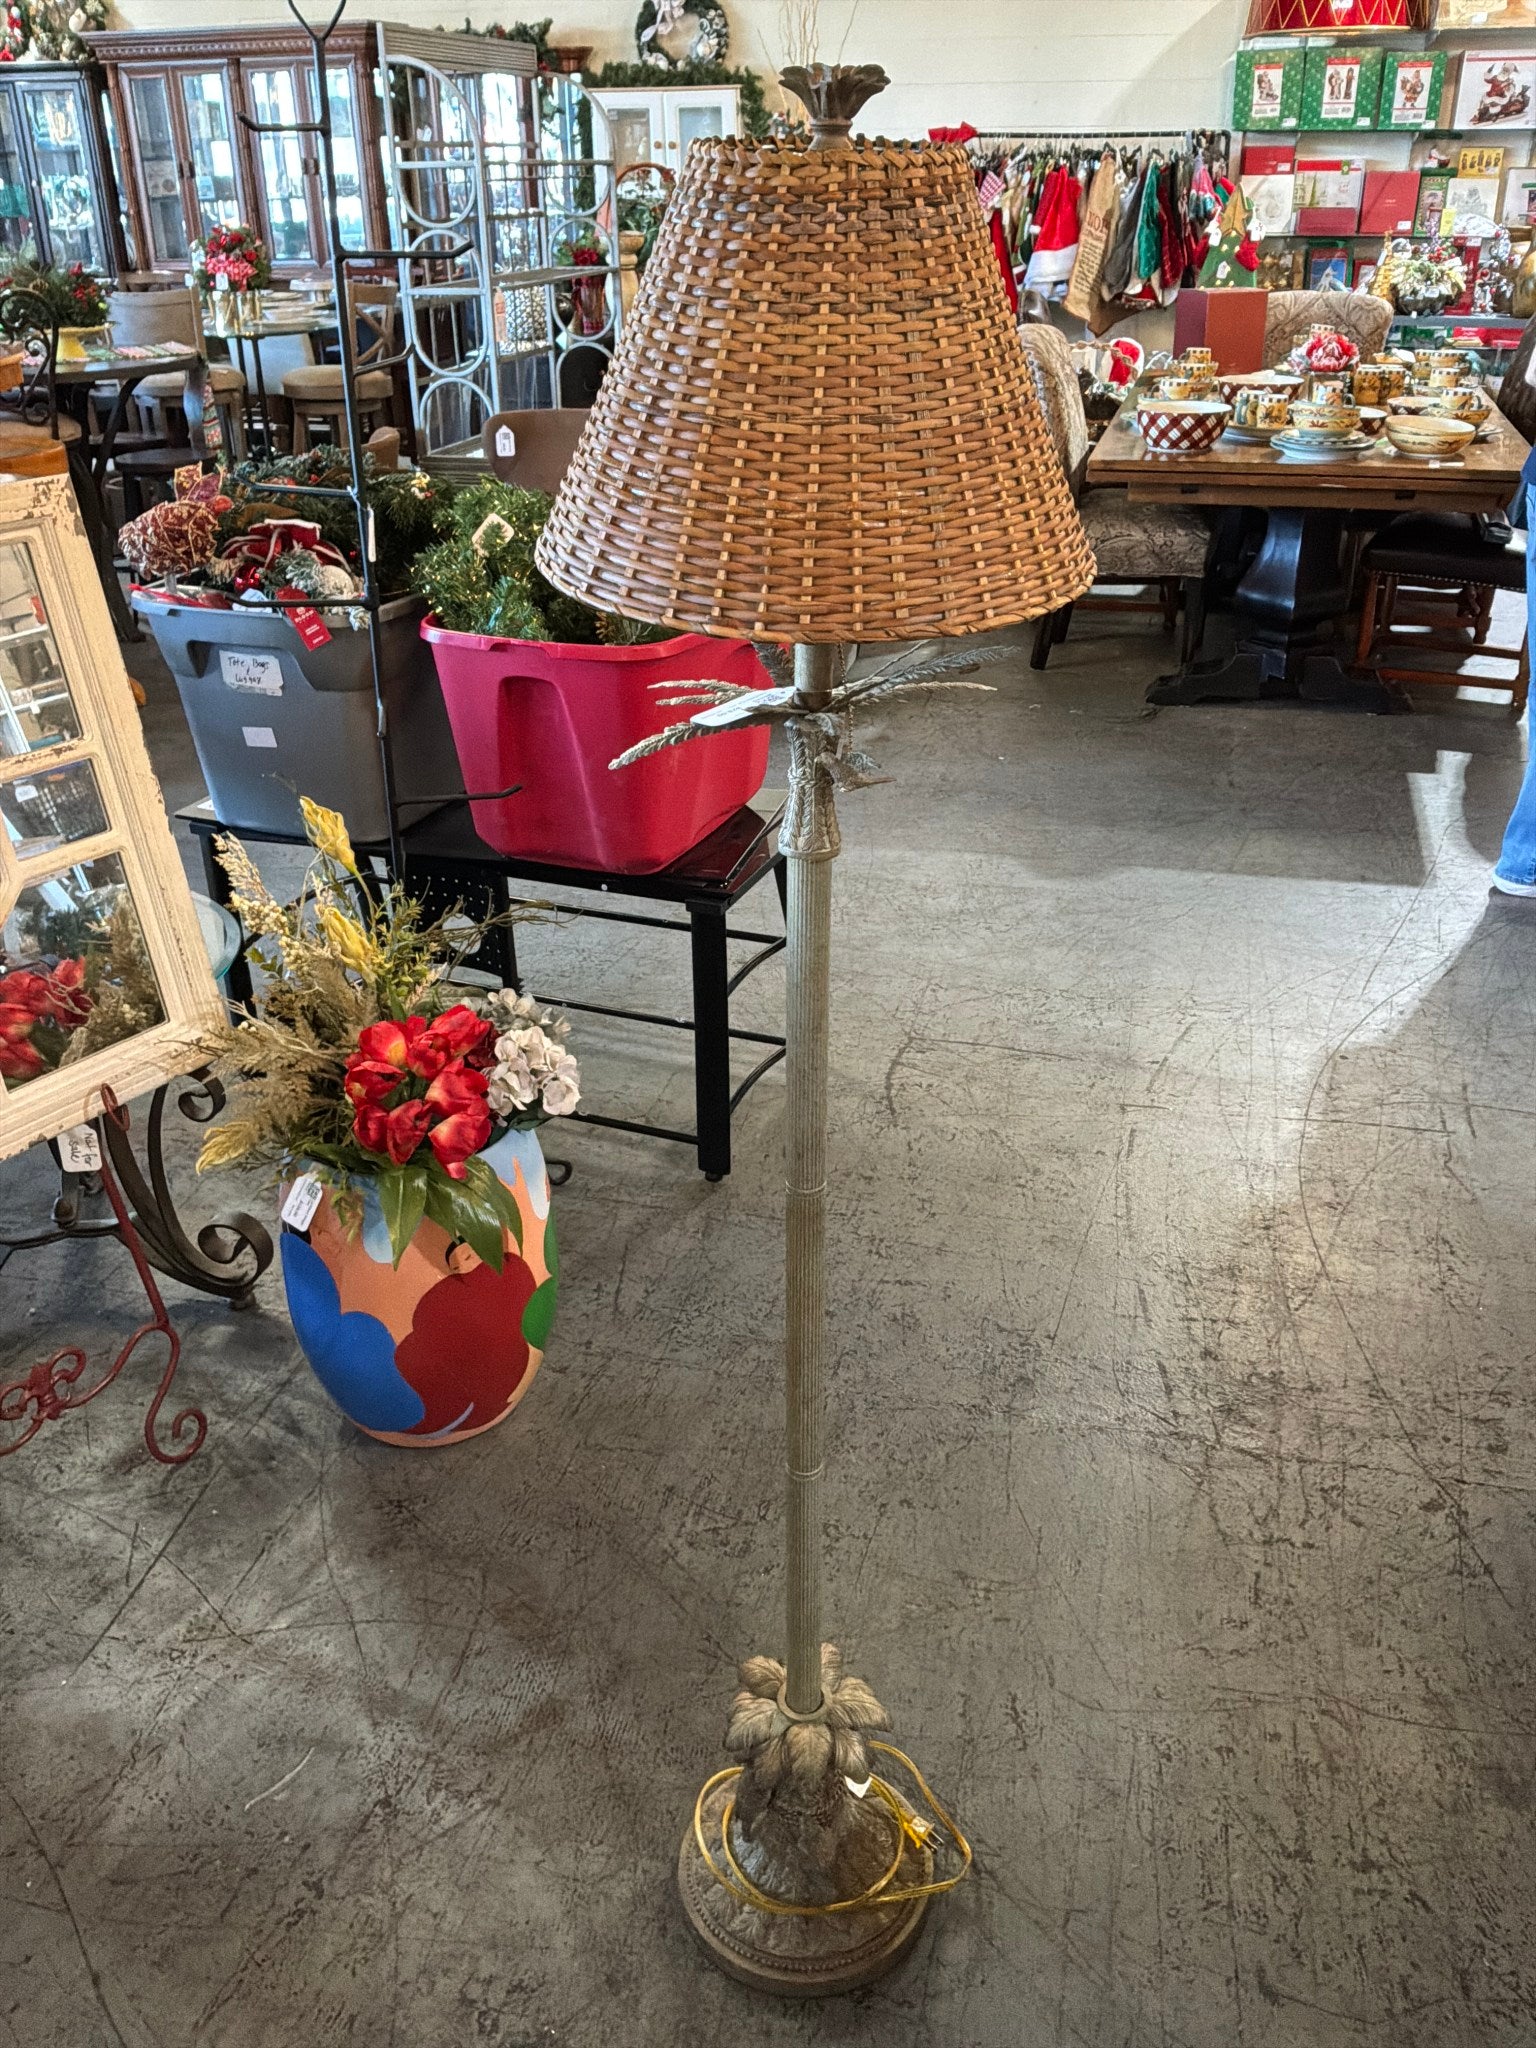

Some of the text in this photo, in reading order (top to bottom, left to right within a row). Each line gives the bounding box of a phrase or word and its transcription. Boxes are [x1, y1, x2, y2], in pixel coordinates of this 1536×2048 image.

[228, 656, 245, 667] Tote
[81, 1132, 98, 1168] Not for
